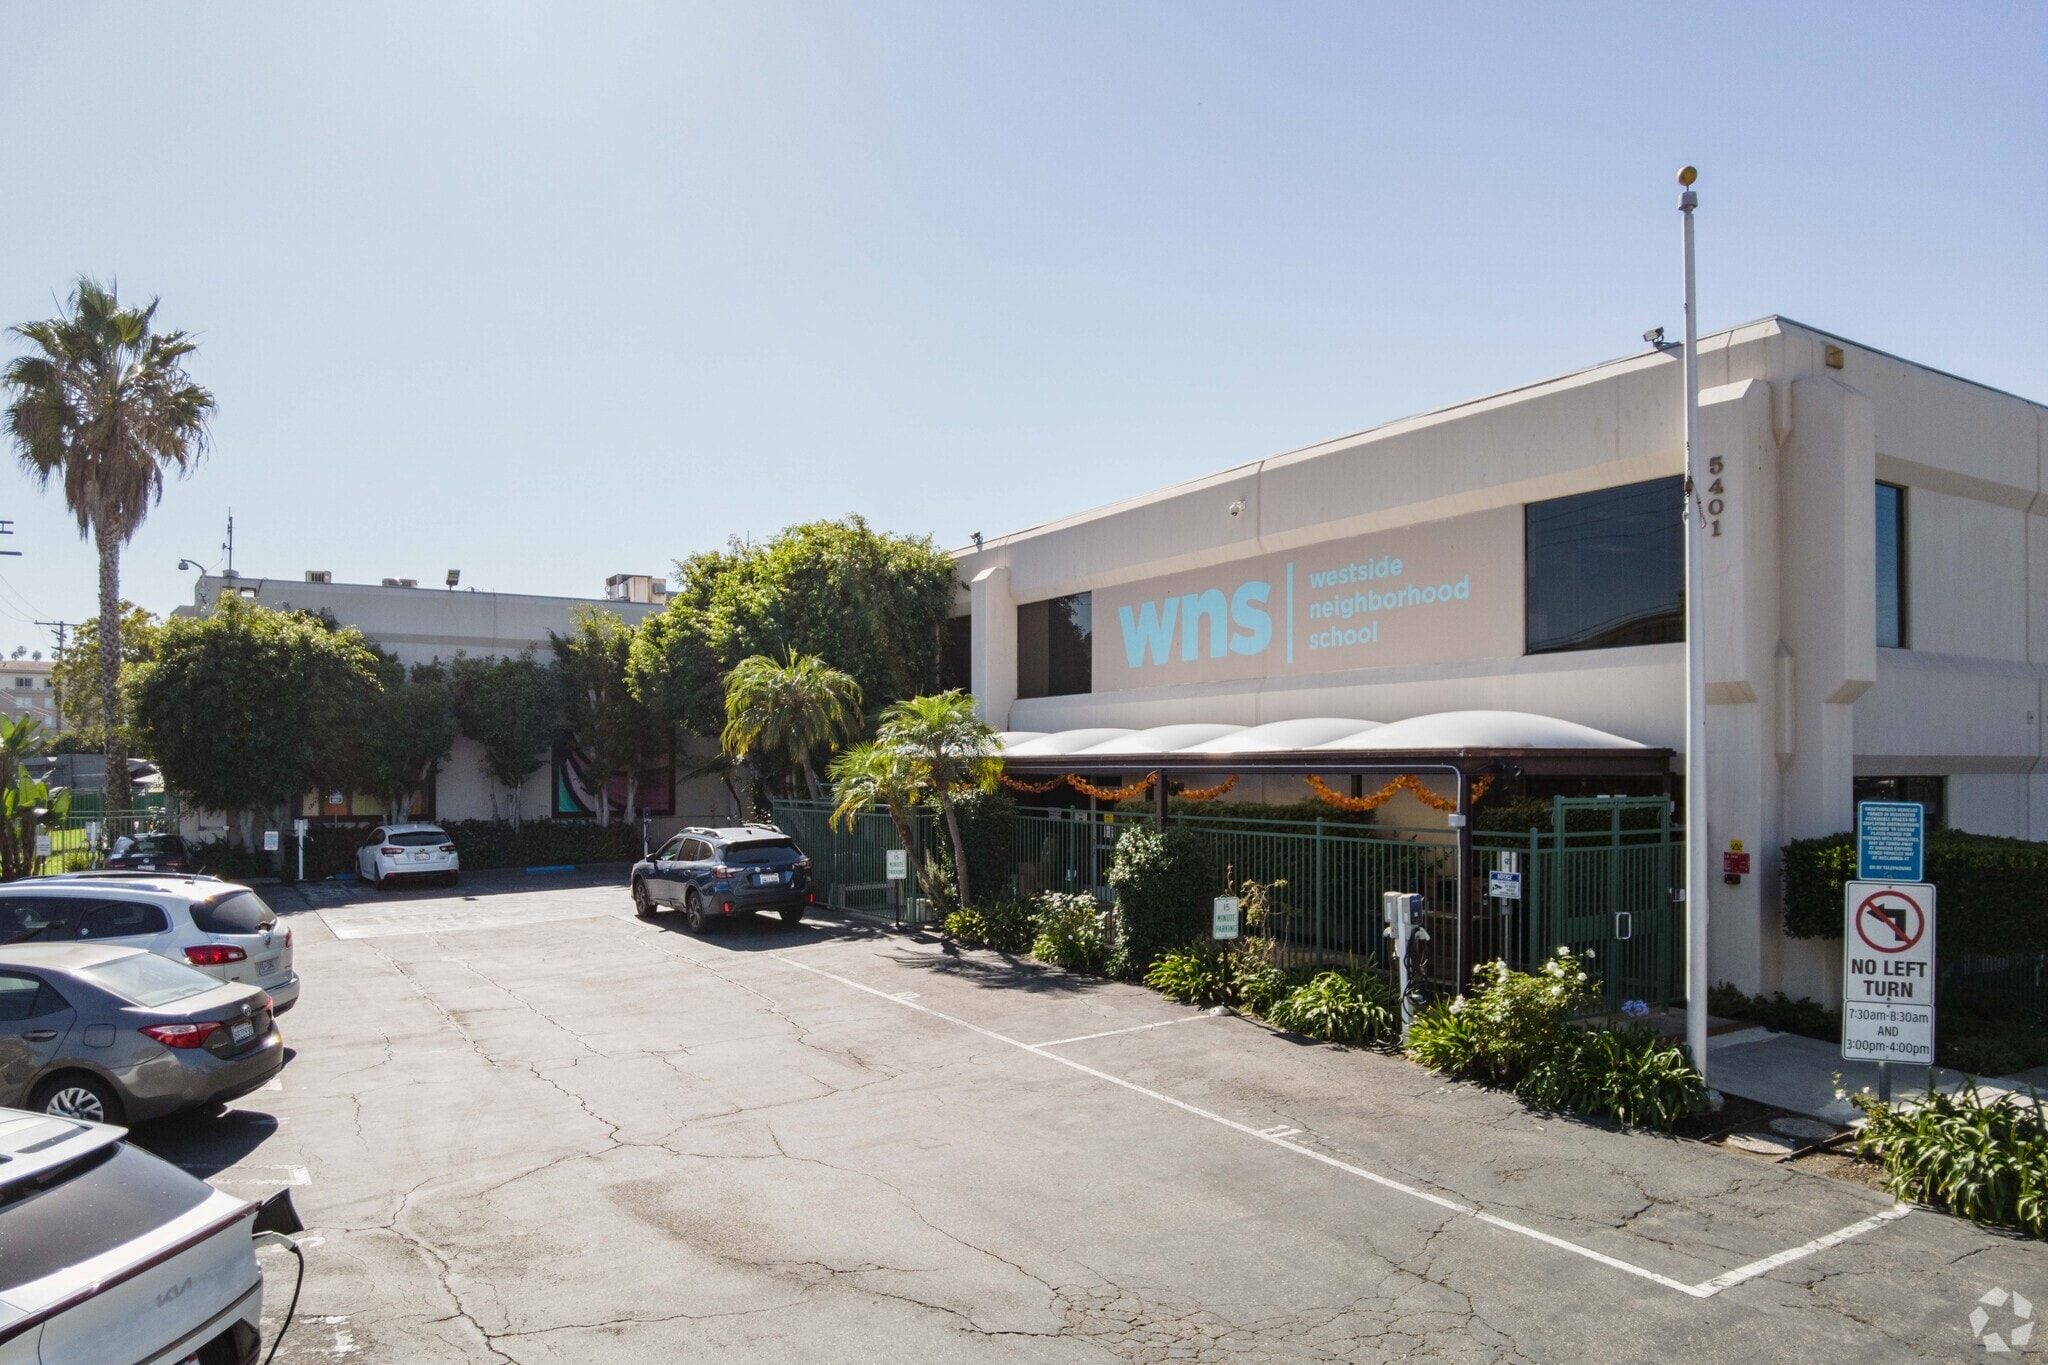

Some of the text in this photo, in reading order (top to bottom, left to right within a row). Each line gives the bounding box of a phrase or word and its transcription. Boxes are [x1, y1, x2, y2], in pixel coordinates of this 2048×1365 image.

[1708, 455, 1724, 537] 5401
[1309, 555, 1404, 589] westside
[1309, 575, 1470, 620] neighborhood
[1118, 580, 1273, 669] wns
[1309, 621, 1379, 650] school
[1223, 903, 1230, 912] 15
[1216, 914, 1236, 922] MINUTE
[1851, 958, 1928, 978] NO LEFT
[1863, 980, 1913, 998] TURN
[1849, 1008, 1929, 1024] 7:30am-8:30am
[1877, 1026, 1899, 1036] AND
[1847, 1038, 1930, 1056] 3:00pm-4:00pm
